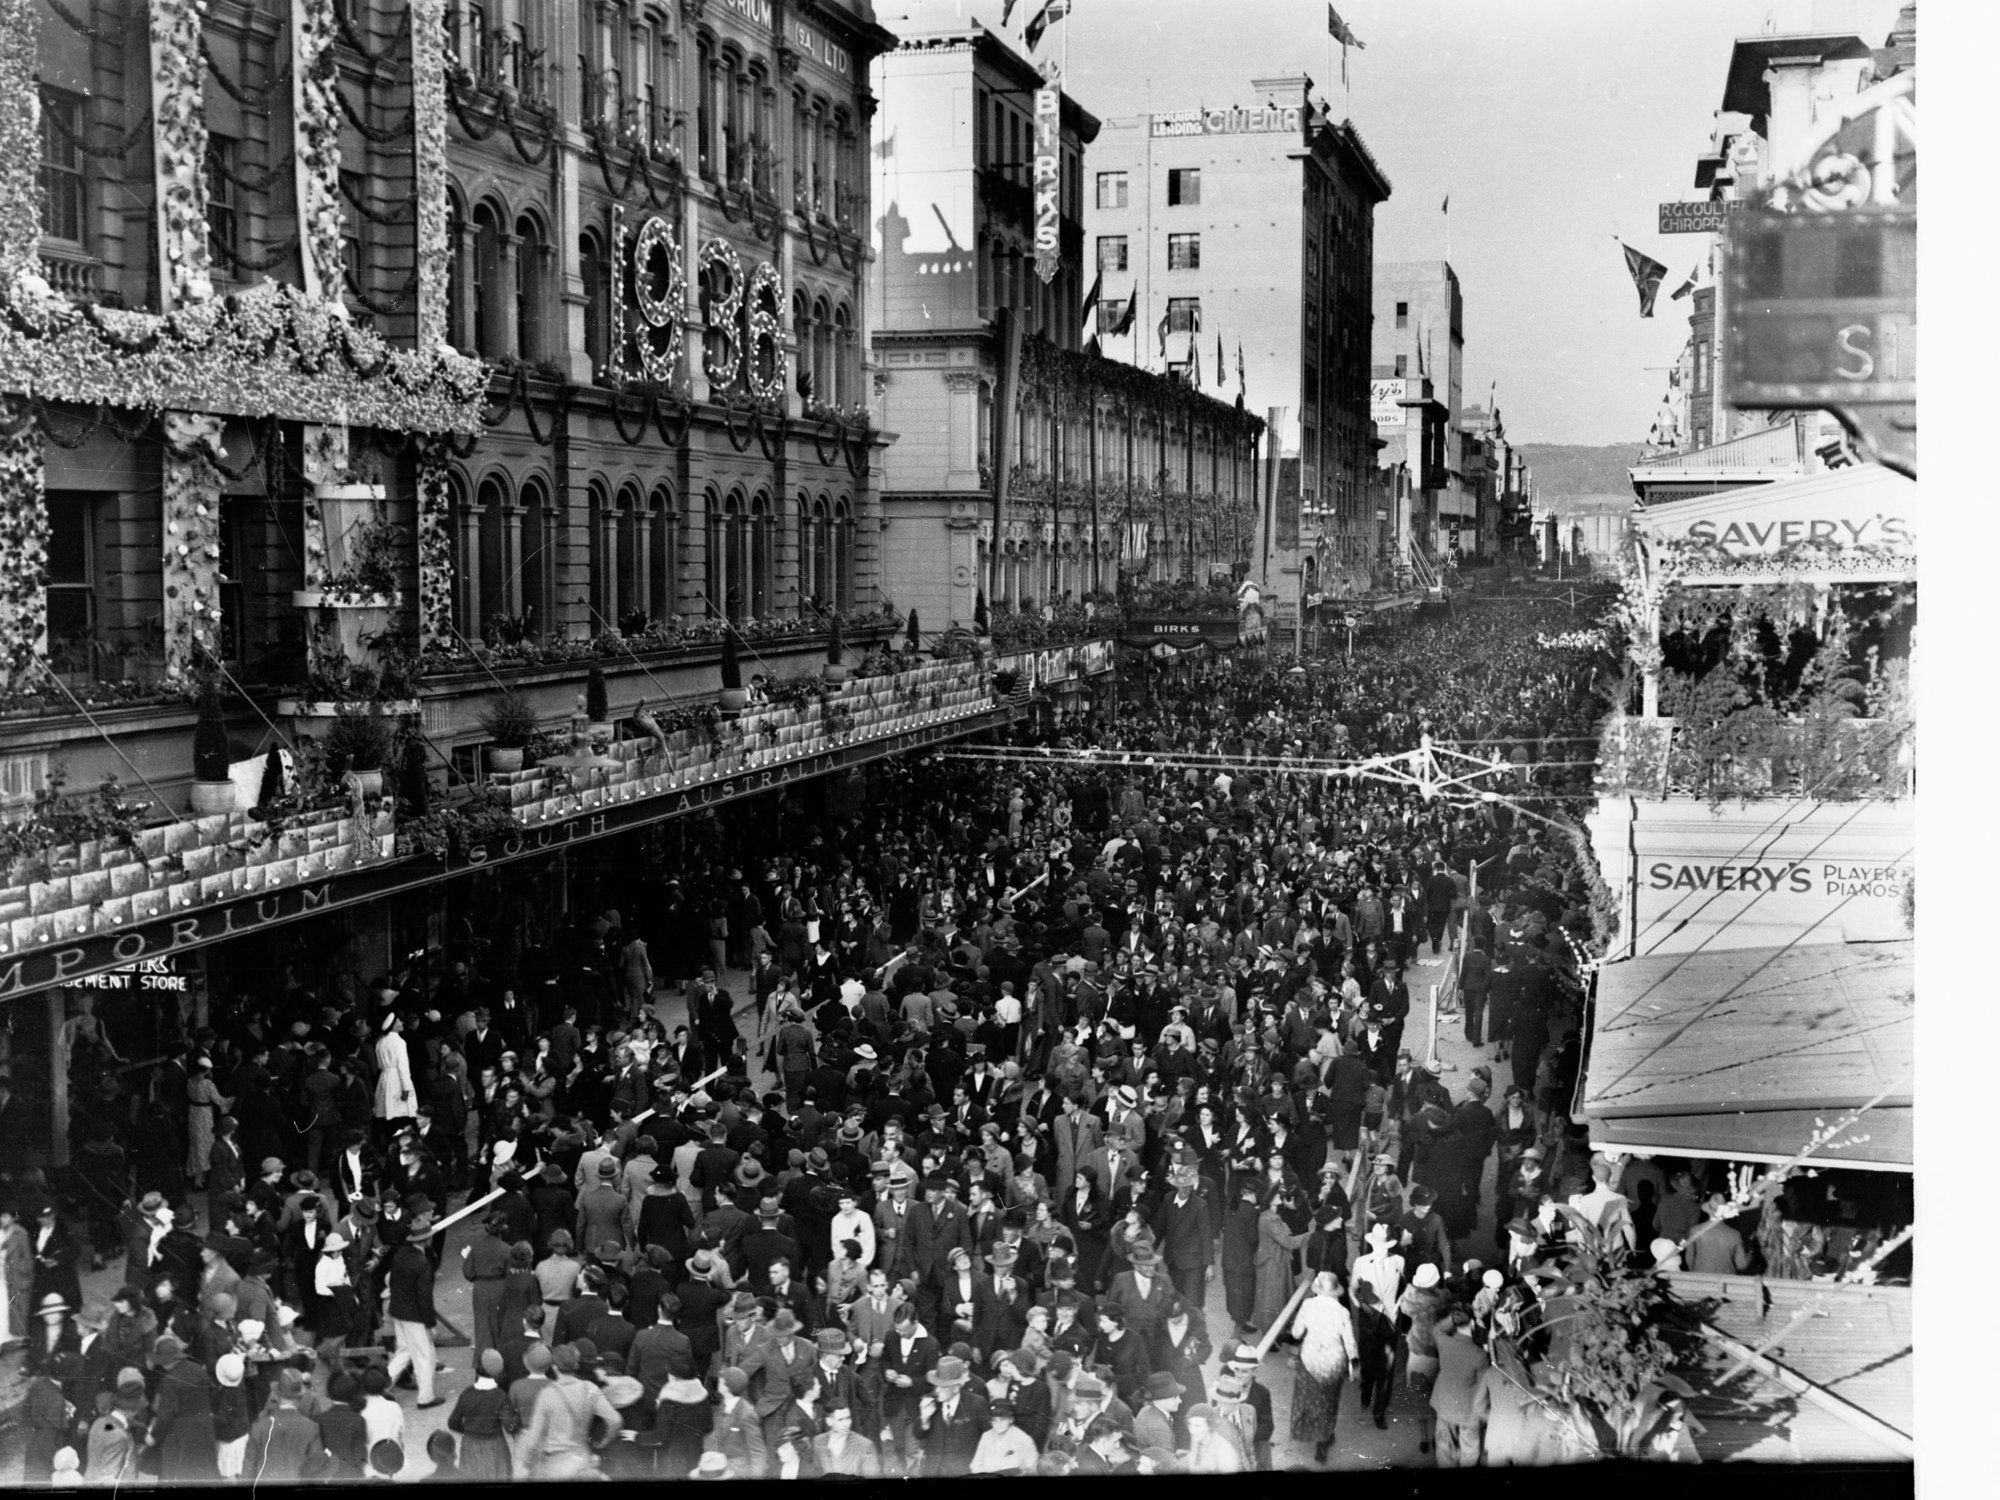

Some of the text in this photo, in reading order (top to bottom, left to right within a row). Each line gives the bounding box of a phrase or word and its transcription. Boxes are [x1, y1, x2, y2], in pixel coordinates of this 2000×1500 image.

[728, 0, 772, 29] RIUM
[824, 39, 847, 73] LTD
[1153, 121, 1203, 136] LEADING
[1205, 108, 1300, 132] CINEMA
[1036, 90, 1059, 250] BIRKS
[611, 203, 787, 399] 1936
[1688, 513, 1913, 548] SAVERY'S
[1154, 625, 1200, 633] BIRKS
[468, 814, 606, 866] SOUTH
[677, 755, 836, 811] AUSTRALIA
[1650, 863, 1812, 893] SAVERY'S
[1824, 865, 1897, 881] PLAYER
[1826, 881, 1900, 898] PIANOS
[141, 975, 187, 992] STORE
